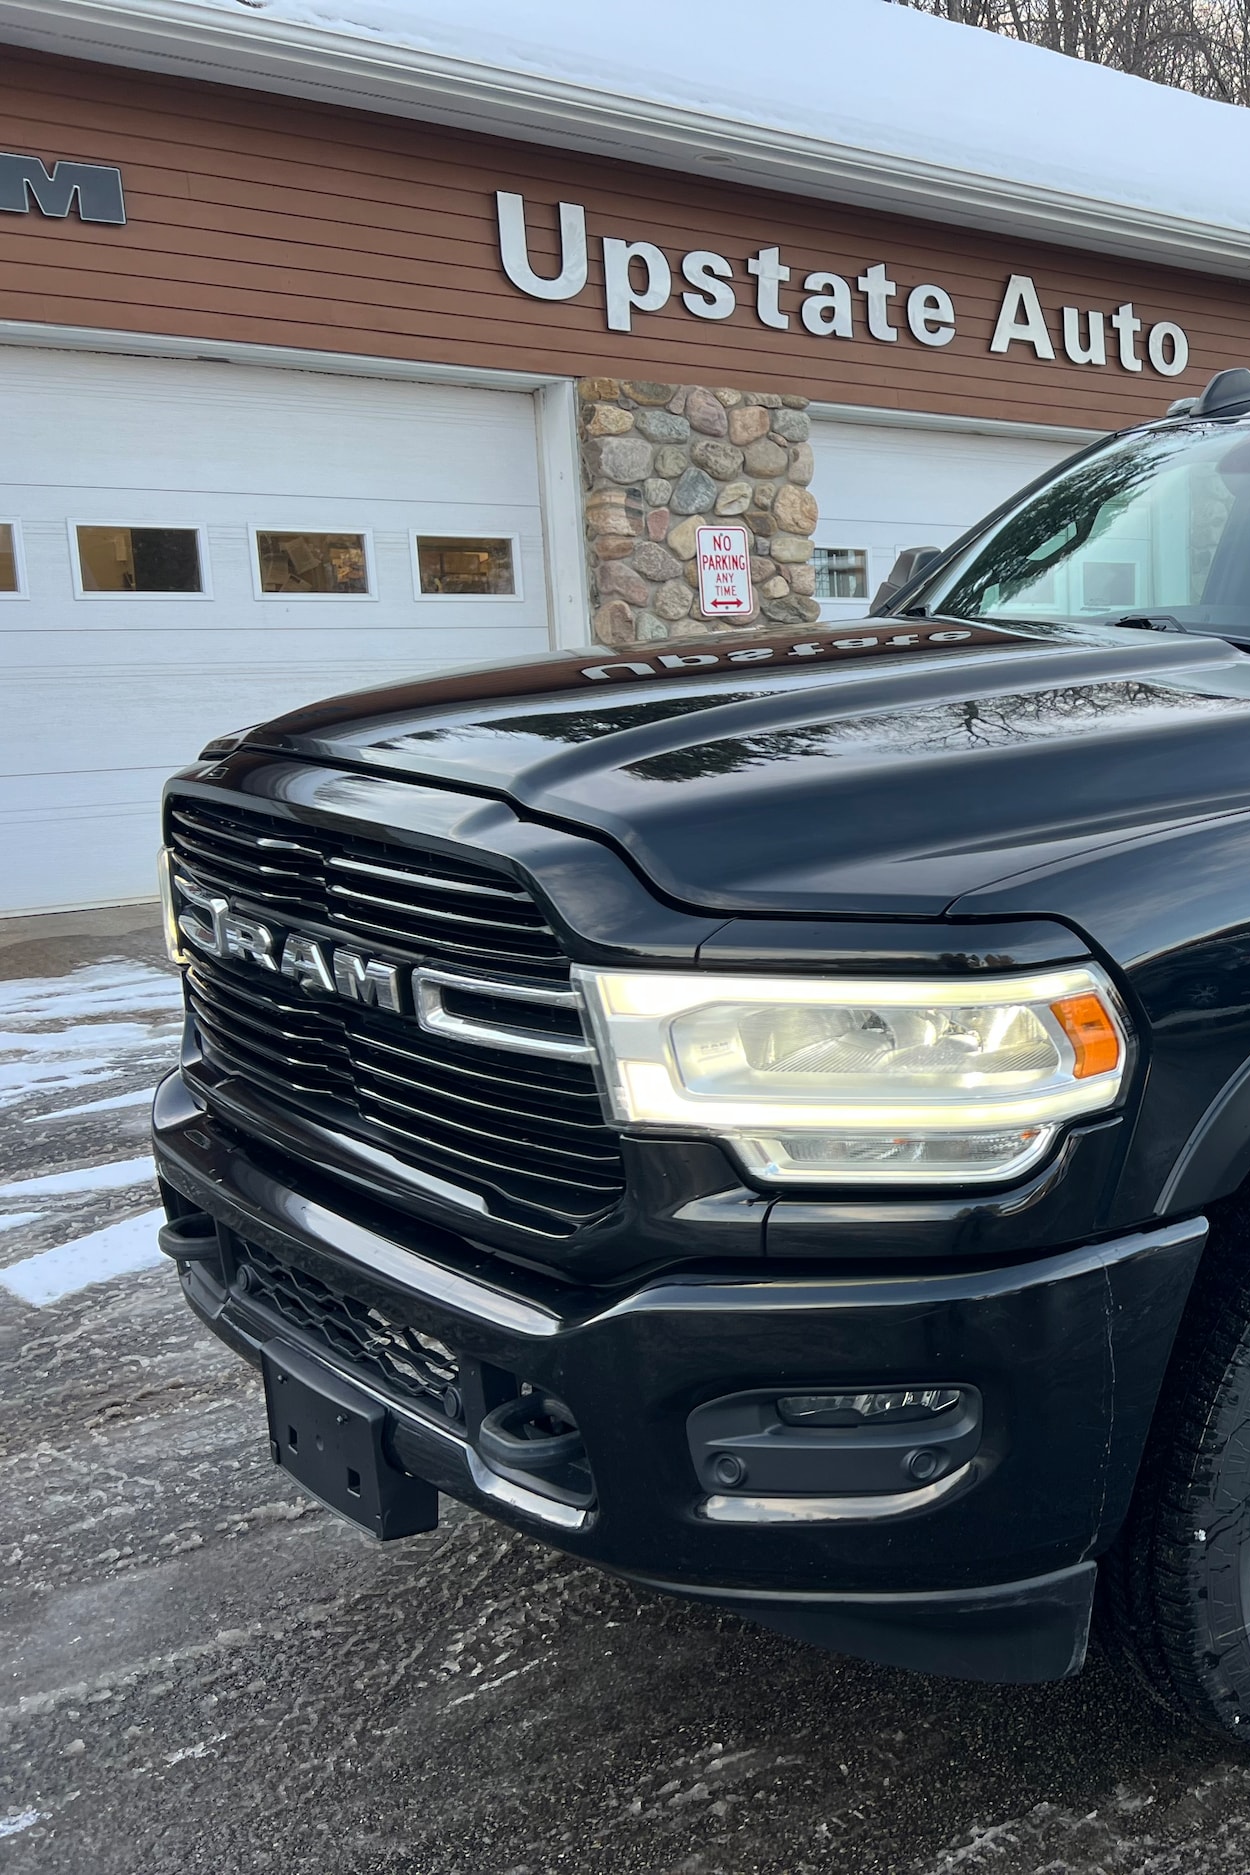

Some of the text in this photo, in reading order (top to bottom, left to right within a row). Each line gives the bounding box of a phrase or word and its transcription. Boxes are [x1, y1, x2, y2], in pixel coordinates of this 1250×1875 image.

[495, 190, 1190, 377] Upstate Auto
[713, 535, 731, 552] NO
[702, 554, 746, 571] PARKING
[716, 572, 734, 583] ANY
[715, 585, 737, 596] TIME
[222, 913, 401, 1014] RAM
